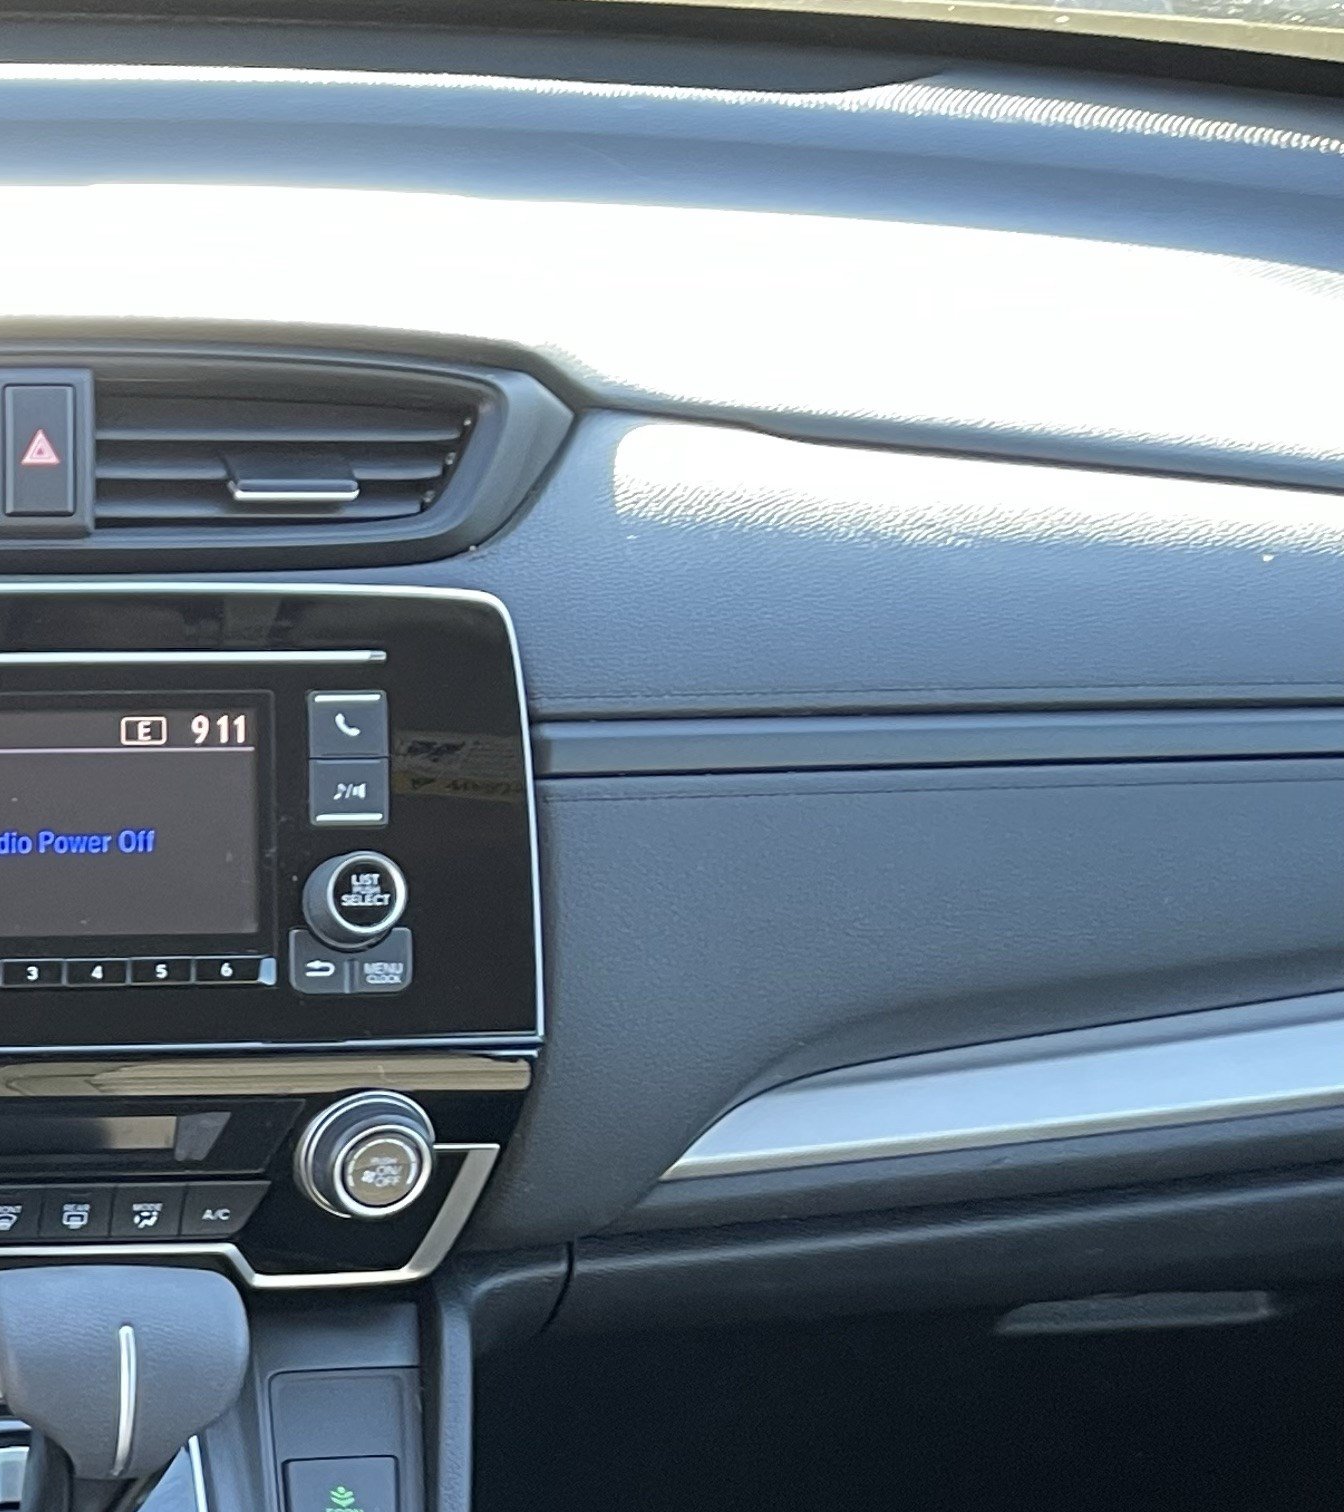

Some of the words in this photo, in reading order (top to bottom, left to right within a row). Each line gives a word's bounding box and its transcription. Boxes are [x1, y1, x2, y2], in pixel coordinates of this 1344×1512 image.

[38, 832, 113, 855] Power
[118, 829, 156, 853] Off
[351, 873, 380, 885] LIST
[341, 894, 391, 907] SELECT
[26, 966, 39, 980] 3
[91, 965, 103, 980] 4
[155, 964, 168, 979] 5
[220, 963, 233, 978] 6
[364, 962, 404, 974] MENU
[201, 1208, 231, 1220] A/C
